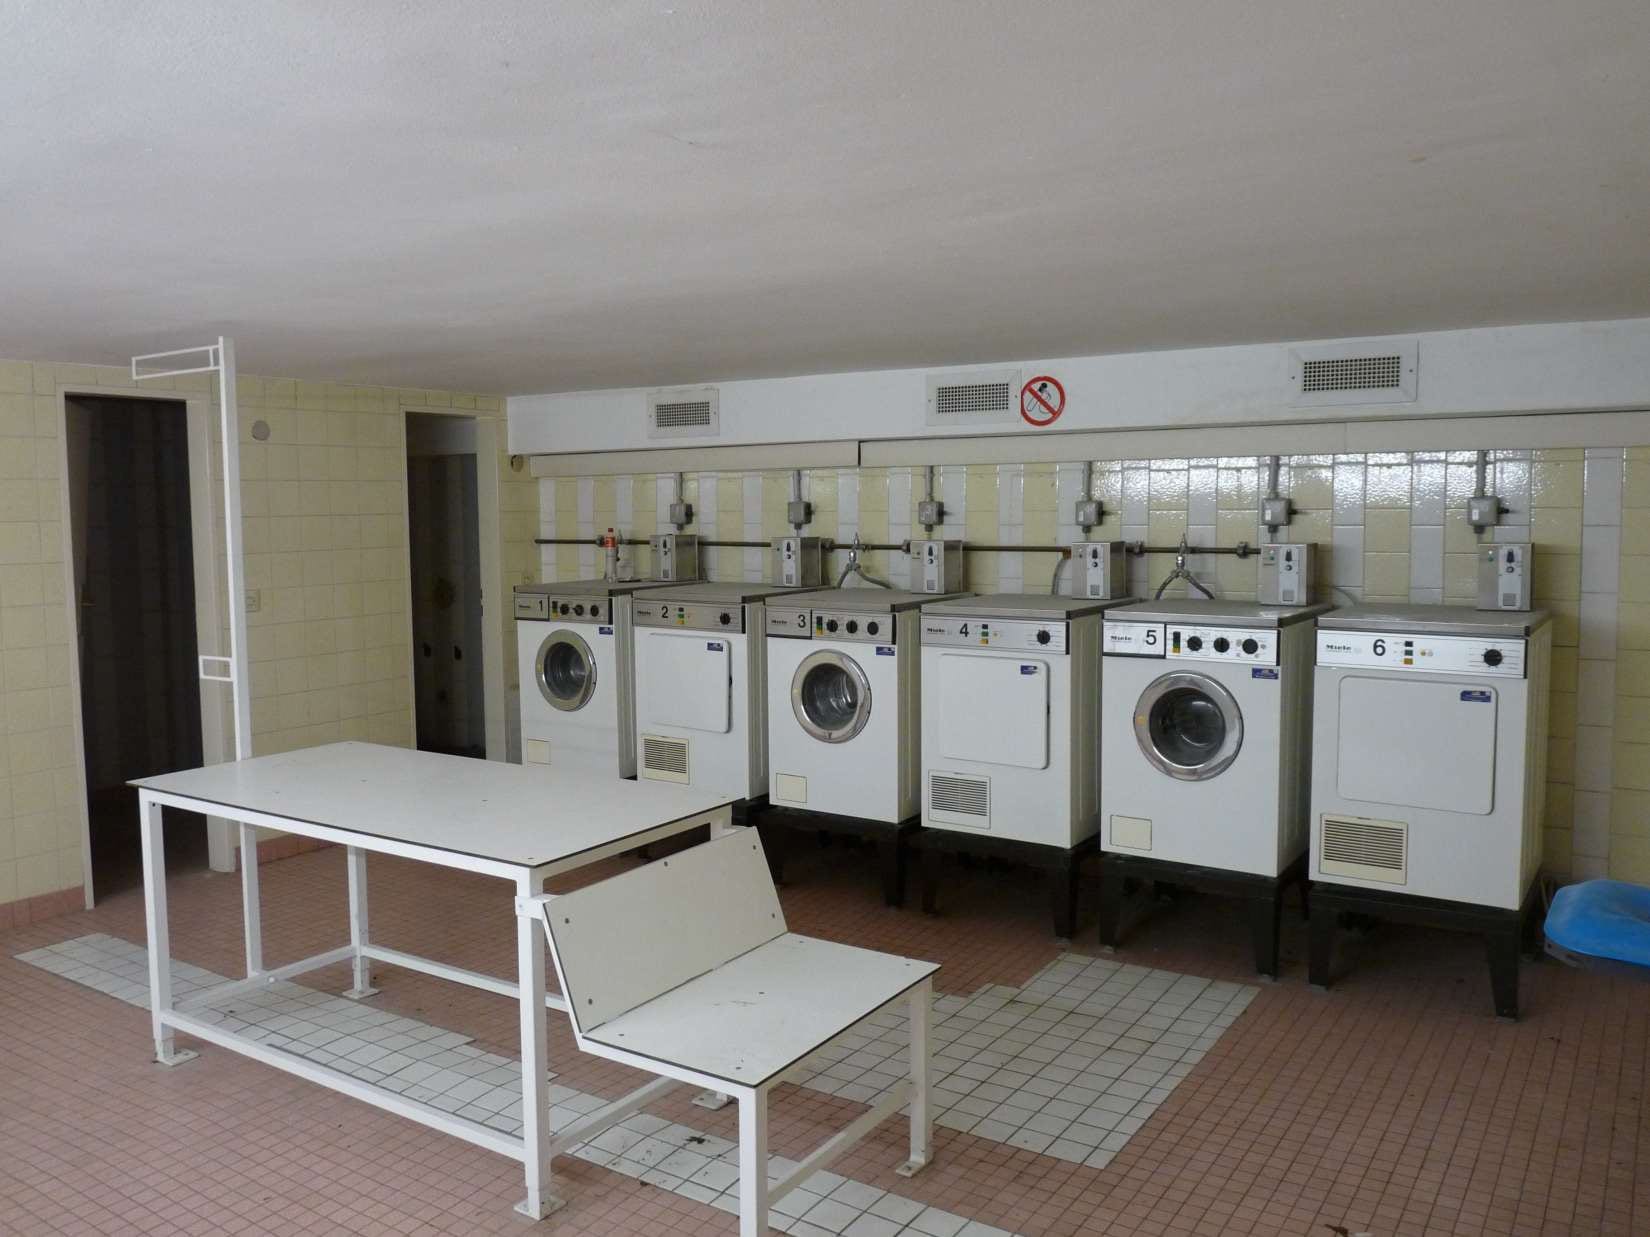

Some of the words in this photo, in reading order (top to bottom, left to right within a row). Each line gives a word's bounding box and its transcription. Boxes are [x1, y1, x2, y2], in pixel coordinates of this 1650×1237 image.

[539, 600, 543, 611] 1
[661, 606, 668, 618] 2
[797, 614, 806, 628] 3
[960, 623, 969, 637] 4
[1145, 630, 1157, 645] 5
[1373, 639, 1386, 656] 6
